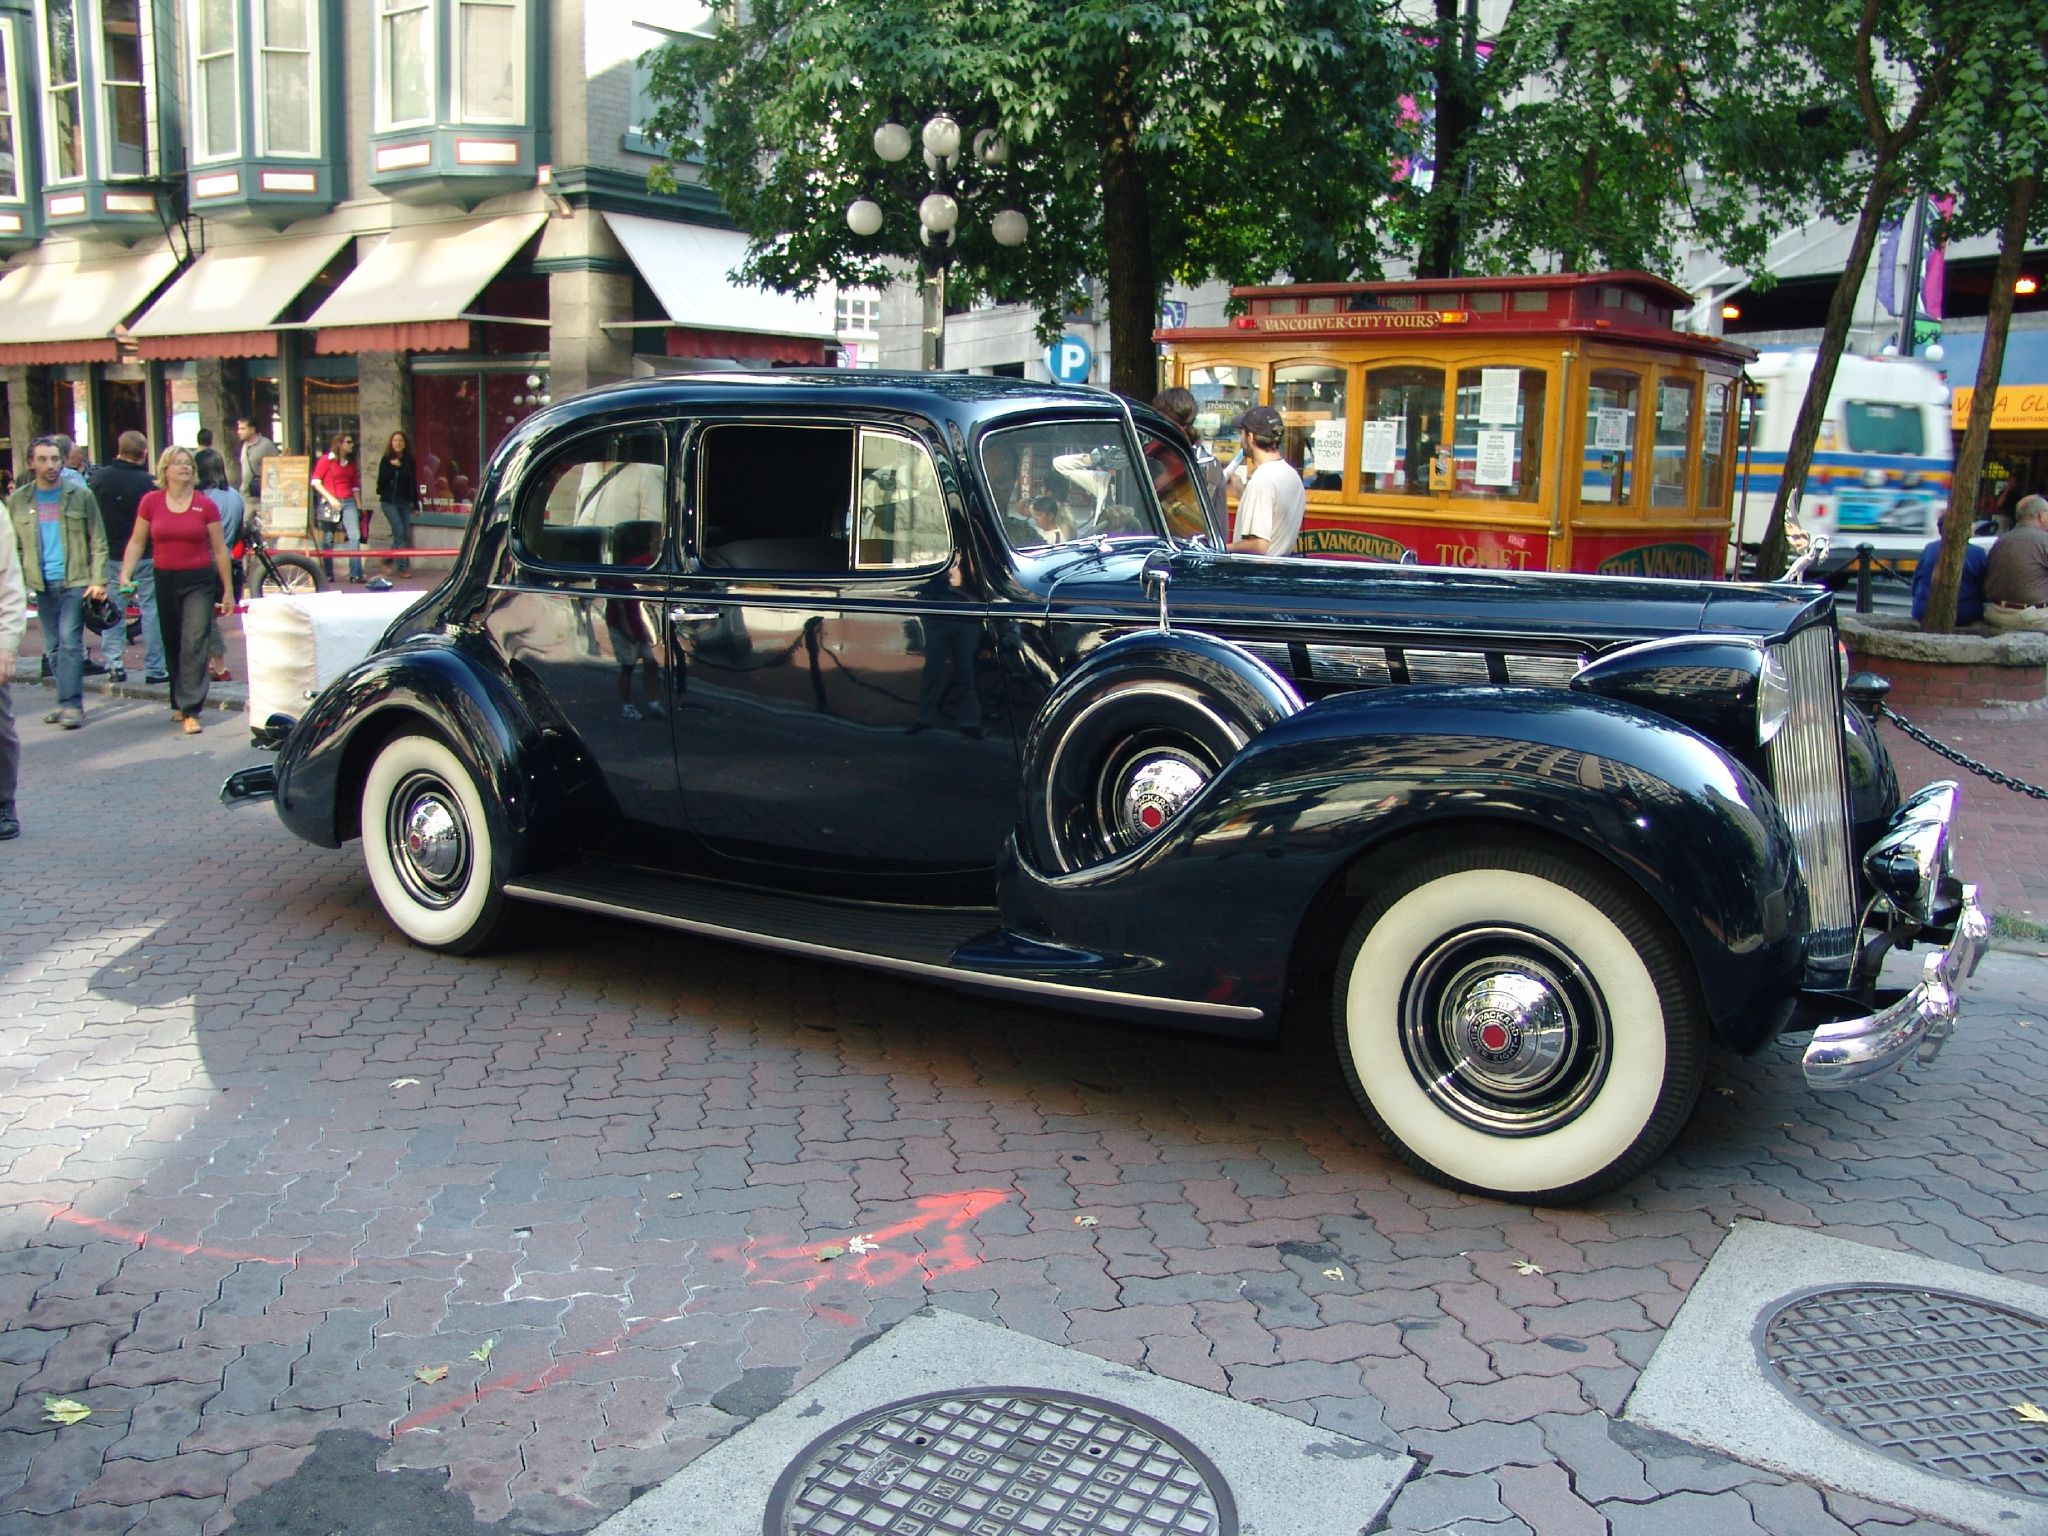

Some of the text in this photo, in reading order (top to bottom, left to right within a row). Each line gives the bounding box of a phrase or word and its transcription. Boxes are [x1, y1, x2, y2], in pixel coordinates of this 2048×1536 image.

[1061, 344, 1085, 378] P
[1316, 440, 1343, 449] CLOSED
[1317, 449, 1341, 458] TODAY
[1317, 532, 1402, 559] VANCOUVER
[1435, 543, 1532, 570] TICKET
[1134, 794, 1170, 810] PACKARD
[1477, 1011, 1519, 1037] PACKARD
[1492, 1041, 1518, 1061] EIGHT
[901, 1449, 987, 1536] SEWER
[1057, 1471, 1122, 1536] CITY
